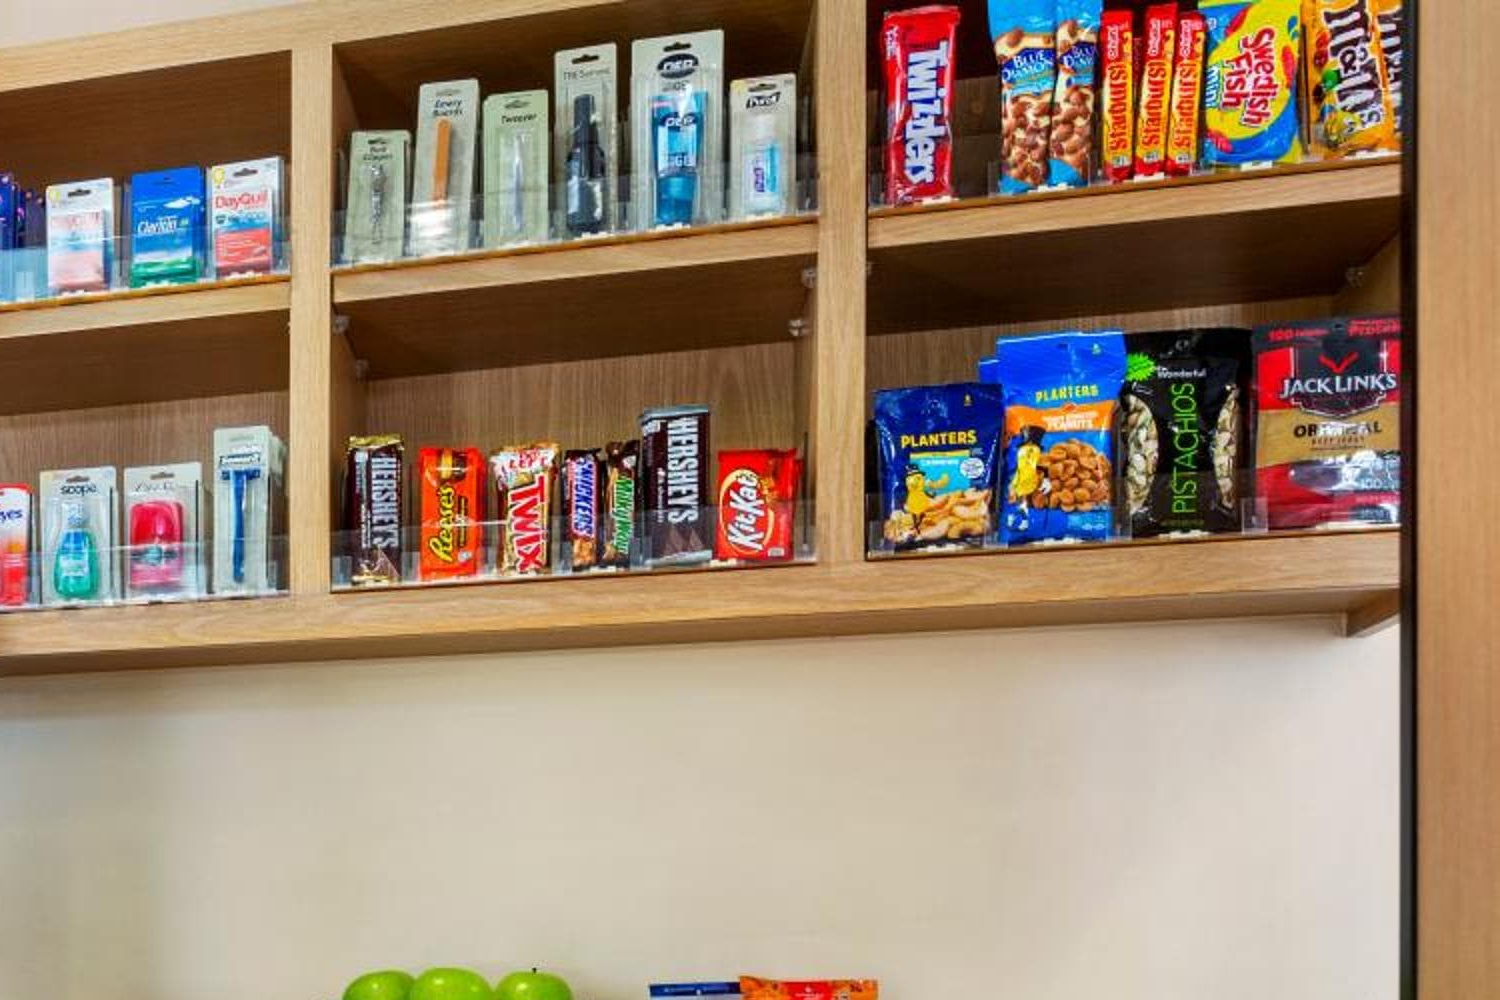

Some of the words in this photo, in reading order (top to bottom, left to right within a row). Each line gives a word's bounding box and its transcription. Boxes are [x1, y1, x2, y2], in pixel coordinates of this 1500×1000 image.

[905, 40, 948, 184] Twizzlers
[1110, 62, 1126, 153] Starburst
[1142, 61, 1166, 147] Starburst
[1173, 61, 1196, 150] Starburst
[1222, 41, 1252, 109] Fish
[1243, 27, 1278, 127] Swedish
[215, 189, 268, 209] DayQuil
[1035, 384, 1099, 403] PLANTERS
[1280, 377, 1334, 399] JACK
[1334, 373, 1397, 395] LINK'S
[901, 428, 978, 449] PLANTERS
[1171, 382, 1197, 514] PISTACHIOS
[572, 458, 596, 537] SNICKERS
